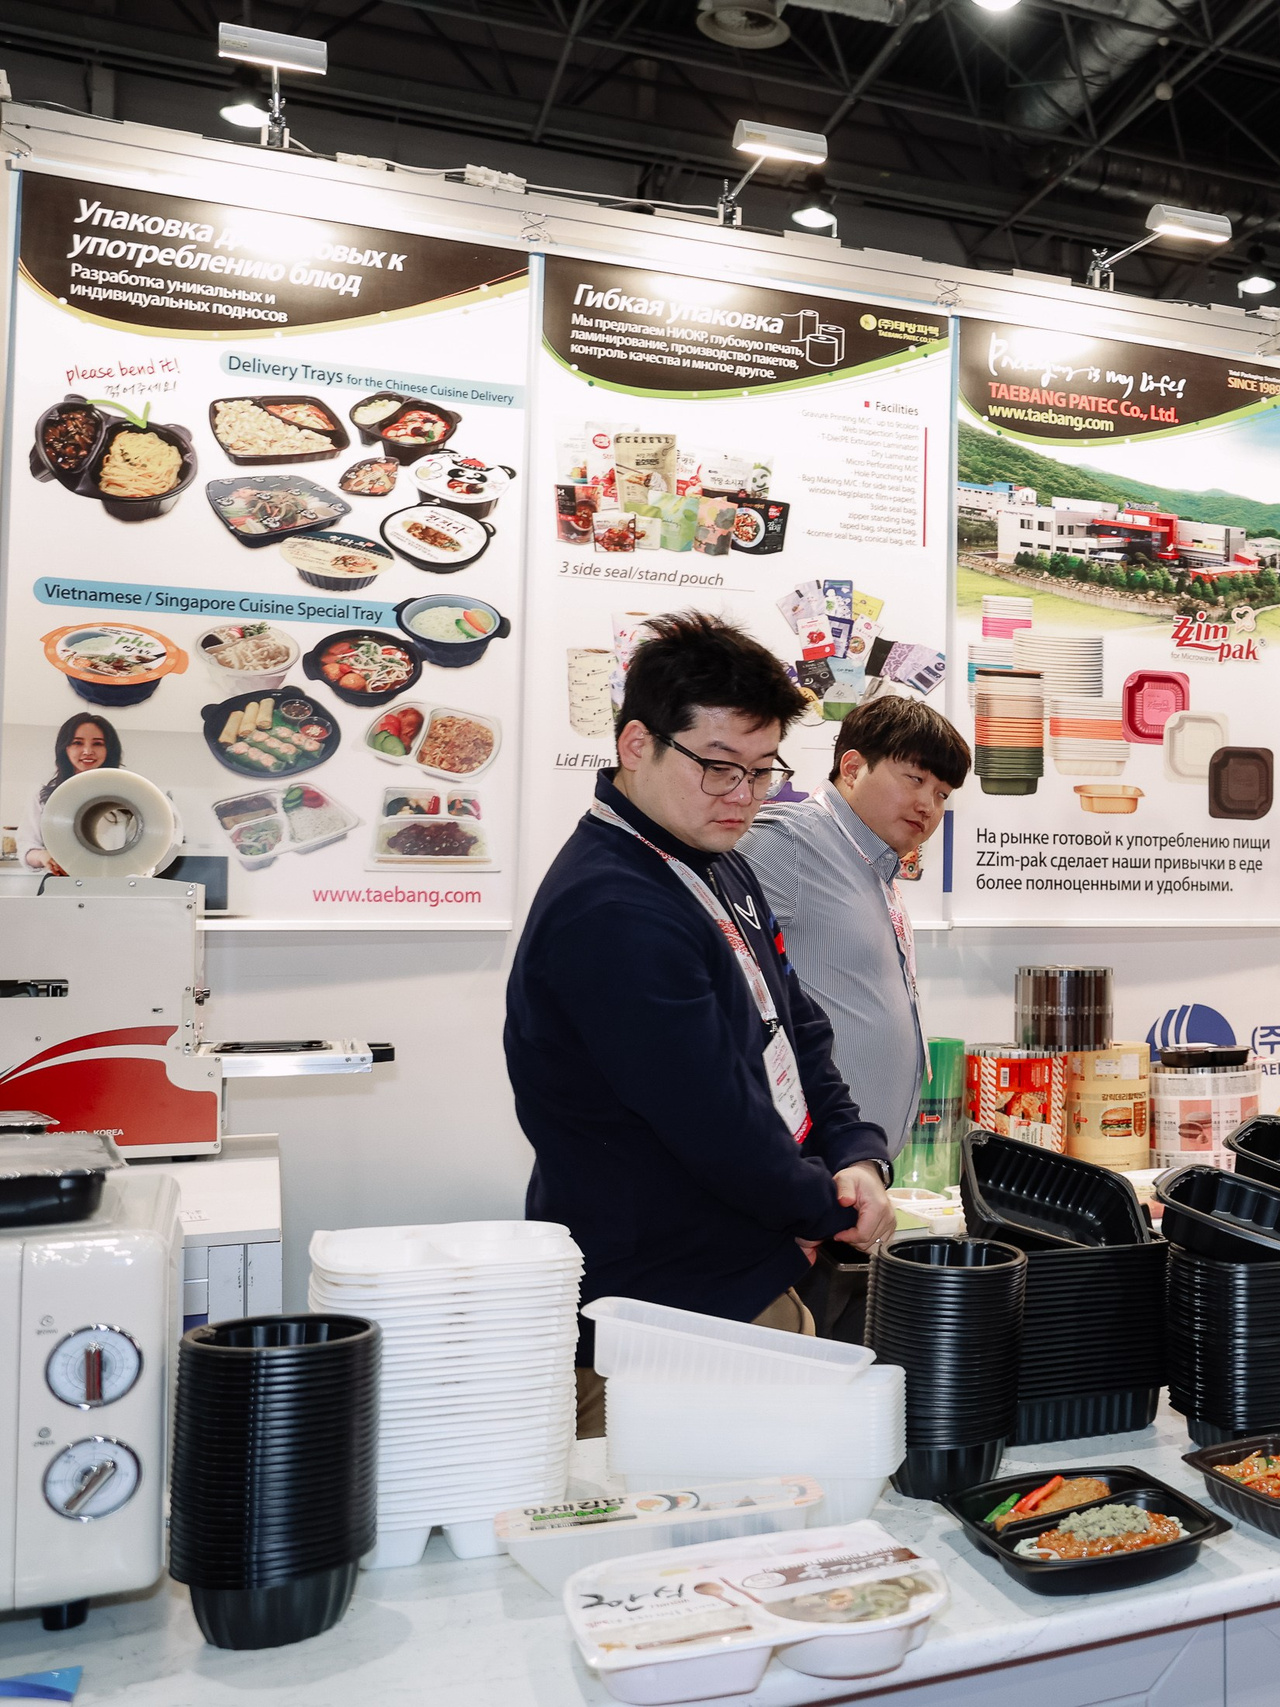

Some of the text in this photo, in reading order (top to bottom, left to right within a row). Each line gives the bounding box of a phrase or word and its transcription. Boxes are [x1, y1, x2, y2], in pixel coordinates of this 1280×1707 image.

[73, 198, 214, 242] Упаковка
[386, 253, 407, 272] к
[66, 233, 285, 281] употреблению
[290, 261, 362, 297] блюд
[70, 262, 276, 305] Разработка уникальных и
[69, 284, 288, 323] индивидуальных подносов
[572, 283, 785, 335] Гибкая упаковка
[569, 328, 800, 371] ламинирование, производство пакетов,
[570, 312, 805, 359] Мы предлагаем НИОКР, глубокую печать,
[65, 356, 180, 386] please bend it!
[569, 343, 628, 361] контроль
[628, 351, 681, 369] качества
[691, 360, 734, 374] многое
[734, 364, 777, 381] другое.
[228, 355, 514, 405] Delivery Trays for the Chinese Cuisine Delivery
[1088, 366, 1101, 383] is
[1105, 370, 1133, 400] my
[1226, 376, 1258, 392] SINCE
[875, 400, 919, 416] Facilities
[988, 381, 1180, 424] TAEBANG PATEC Co., Ltd.
[988, 404, 1115, 432] www.taebang.com
[560, 561, 724, 588] 3 side seal/stand pouch
[44, 583, 142, 605] Vietnamese
[155, 591, 236, 614] Singapore
[239, 597, 295, 615] Cuisine
[297, 601, 350, 622] Special
[351, 604, 383, 624] Tray
[1218, 637, 1260, 663] pak
[555, 753, 612, 768] Lid Film
[976, 828, 1271, 852] На рынке готовой к употреблению пищи
[976, 851, 1263, 874] ZZim-pak сделает наши привычки в еде
[312, 885, 482, 908] www.taebang.com
[976, 873, 1234, 896] более полноценными и удобными.
[93, 1128, 124, 1136] KOREA
